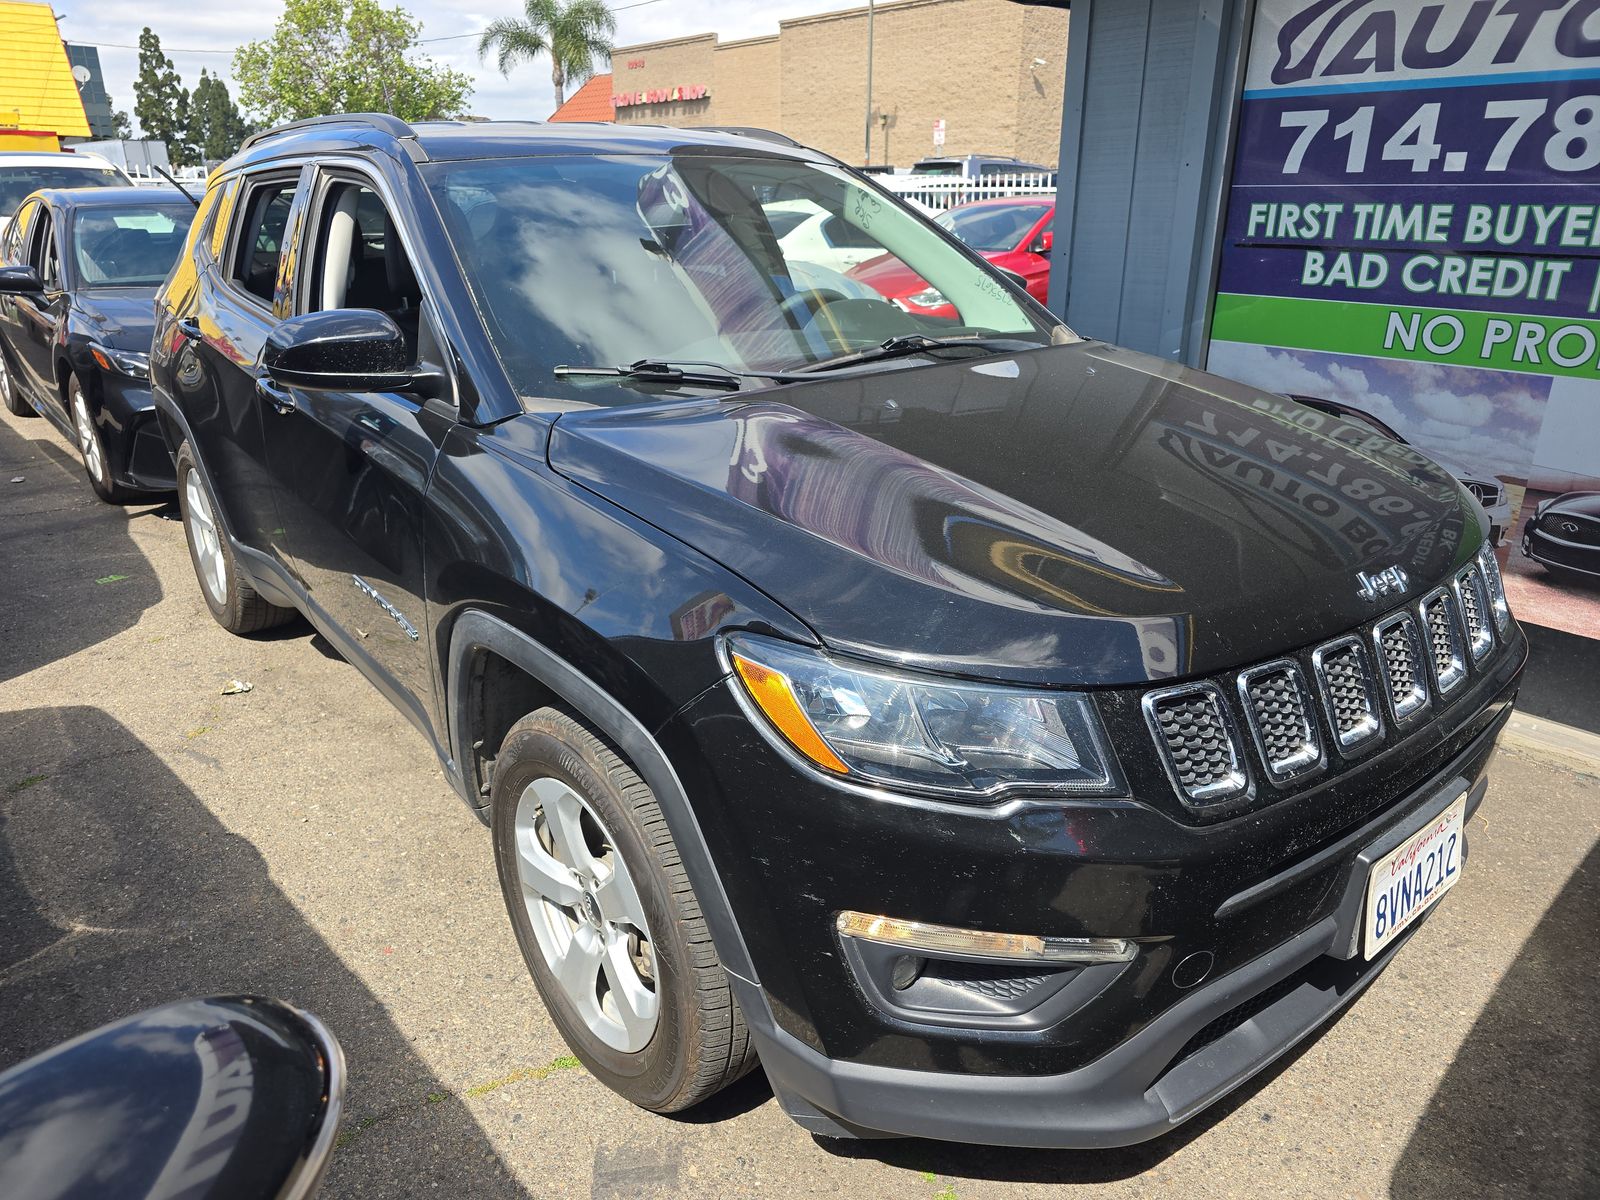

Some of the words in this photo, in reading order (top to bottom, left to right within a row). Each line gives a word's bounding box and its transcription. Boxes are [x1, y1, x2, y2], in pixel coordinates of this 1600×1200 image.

[1279, 95, 1600, 174] 714.78
[1247, 203, 1344, 240] FIRST
[1353, 204, 1453, 242] TIME
[1302, 251, 1390, 289] BAD
[1402, 255, 1572, 301] CREDIT
[1383, 311, 1466, 355] NO
[1479, 318, 1600, 369] PRO
[1356, 565, 1409, 602] Jeep
[1391, 822, 1449, 877] California
[1375, 832, 1457, 939] 8VNA212
